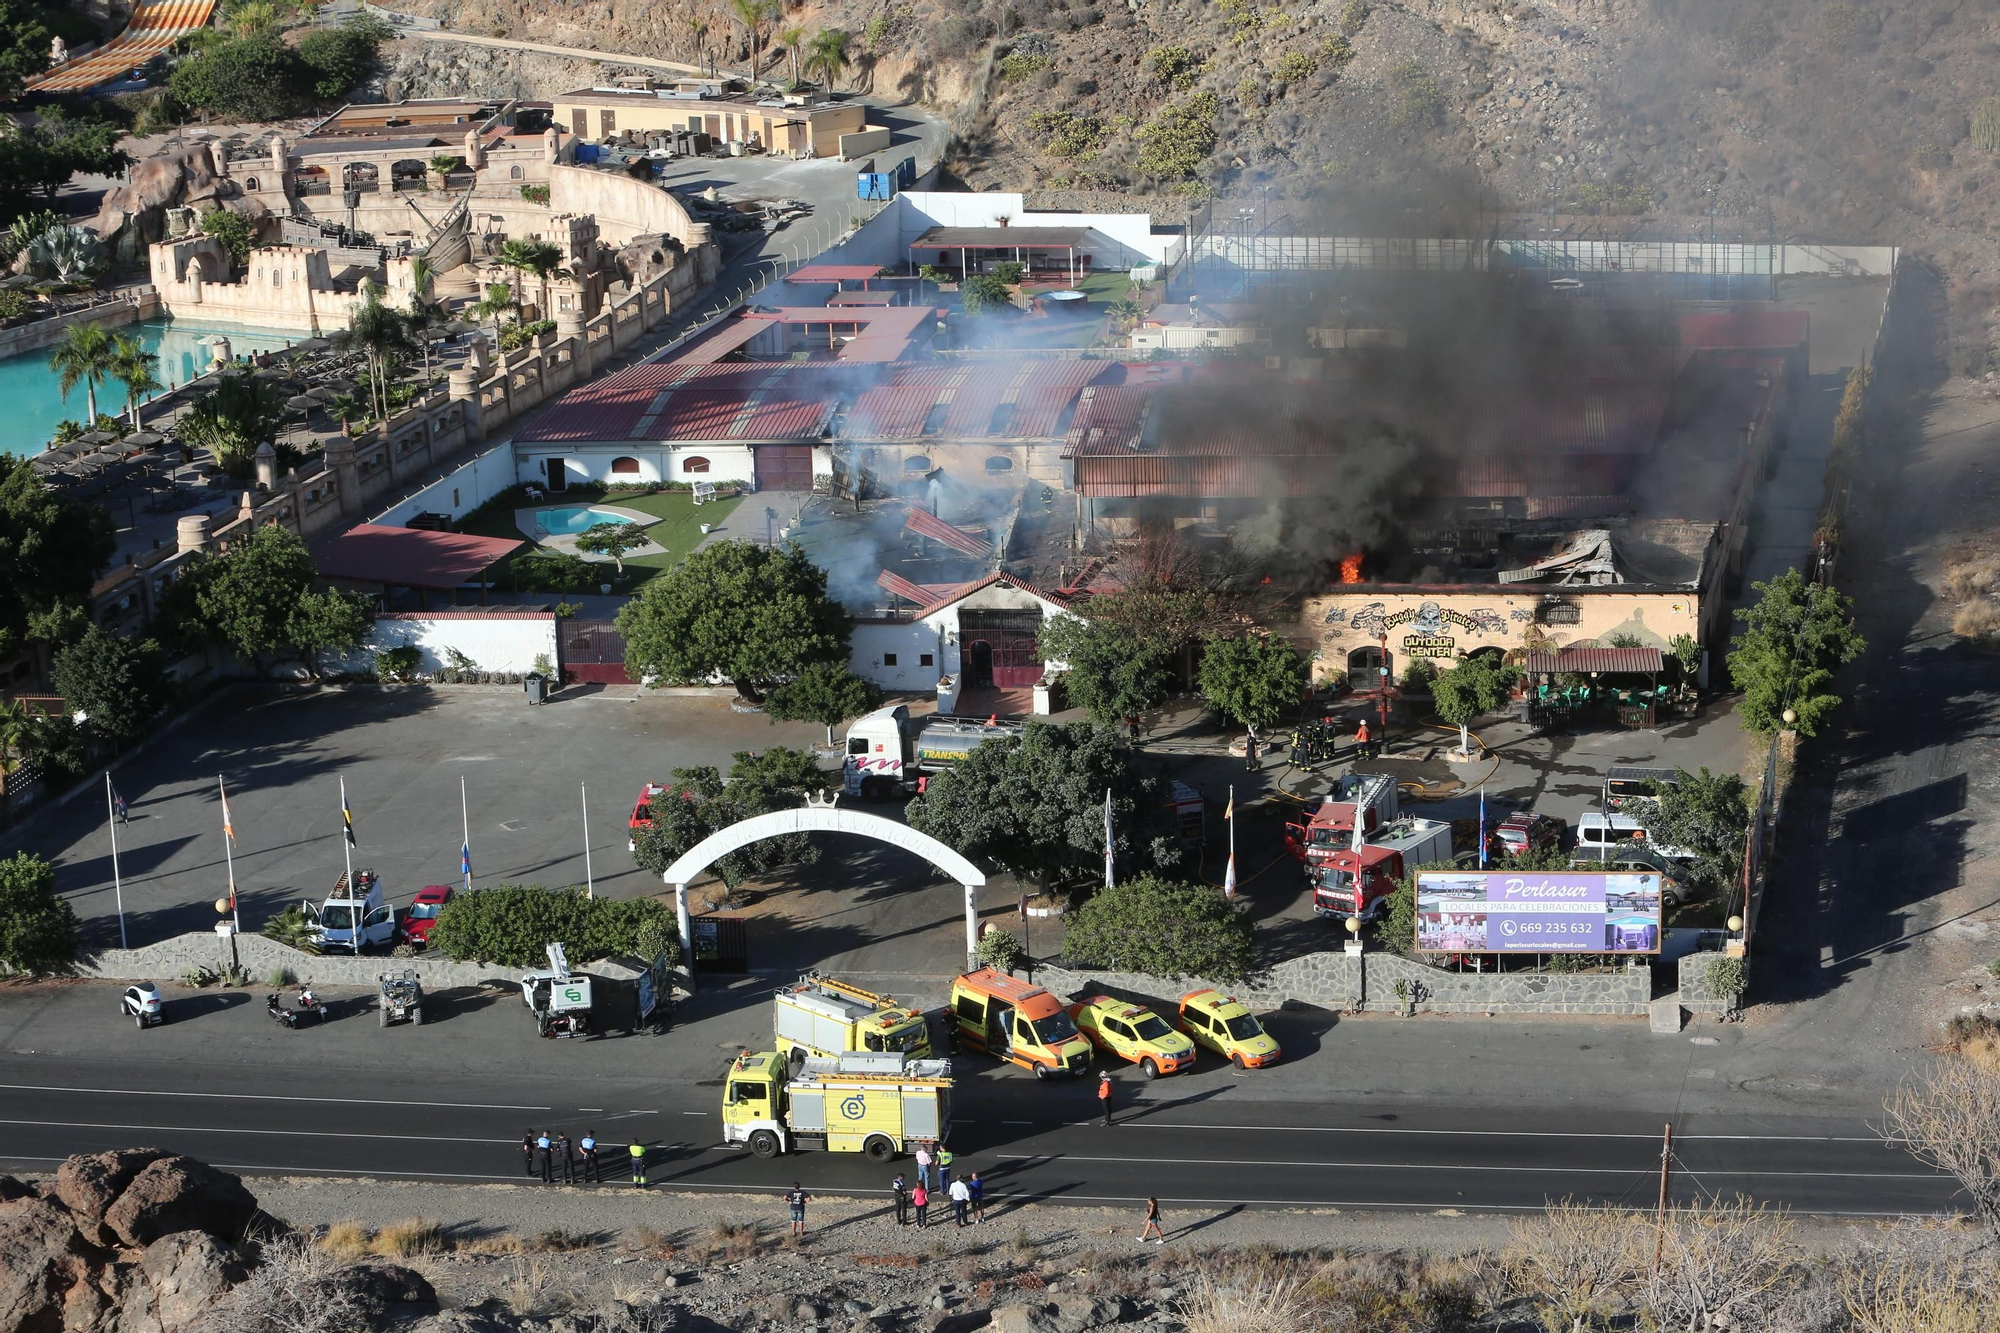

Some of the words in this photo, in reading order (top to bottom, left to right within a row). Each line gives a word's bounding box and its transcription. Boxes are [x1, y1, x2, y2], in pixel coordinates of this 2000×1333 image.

[1384, 608, 1416, 629] Buggy
[1440, 608, 1478, 631] Pirates
[1404, 636, 1454, 647] OUTDOOR
[1409, 647, 1451, 657] CENTER
[923, 749, 970, 761] TRANSPO
[1504, 878, 1588, 899] Perlasur
[1317, 888, 1355, 901] BOMBEROS
[1445, 903, 1487, 911] LOCALES
[1491, 903, 1517, 911] PARA
[1519, 903, 1599, 911] CELEBRACIONES
[1520, 923, 1542, 934] 669
[1545, 923, 1567, 934] 235
[1570, 923, 1592, 934] 632
